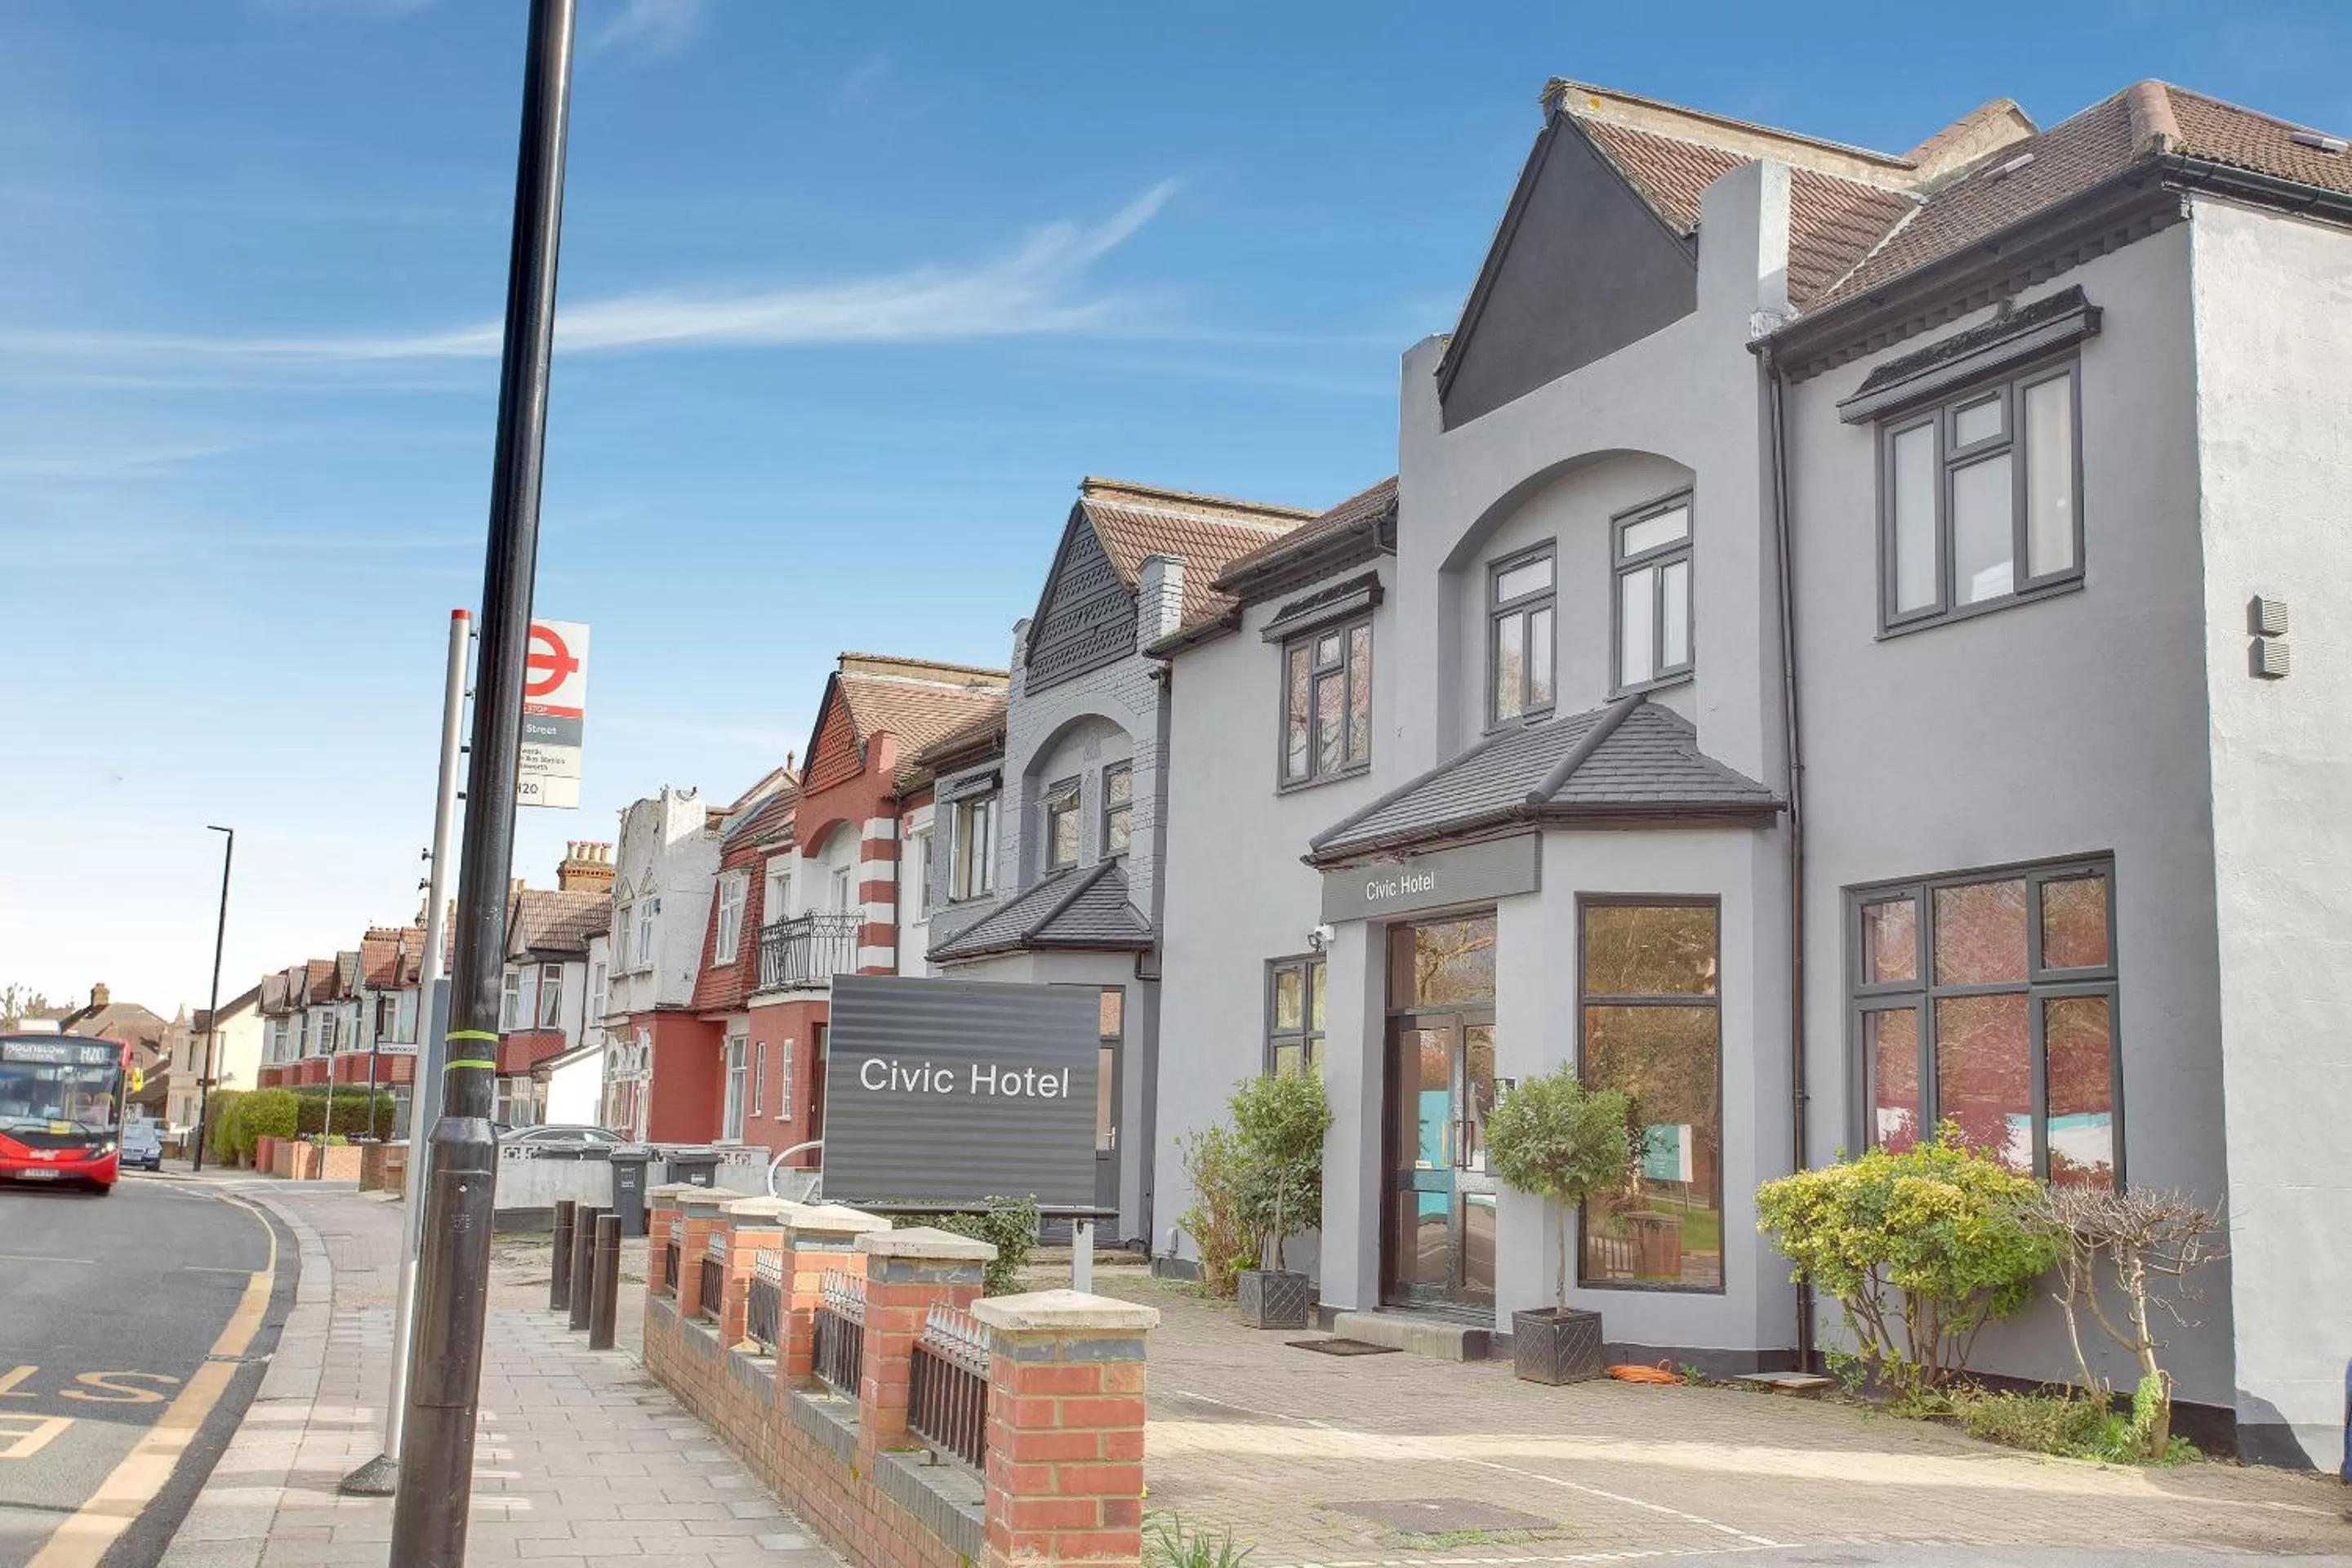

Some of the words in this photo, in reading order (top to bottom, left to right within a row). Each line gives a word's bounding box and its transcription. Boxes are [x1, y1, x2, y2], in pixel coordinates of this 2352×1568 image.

[526, 724, 557, 735] Street
[1366, 880, 1396, 900] Civic
[1401, 872, 1435, 894] Hotel
[860, 1058, 954, 1094] Civic
[970, 1063, 1069, 1098] Hotel
